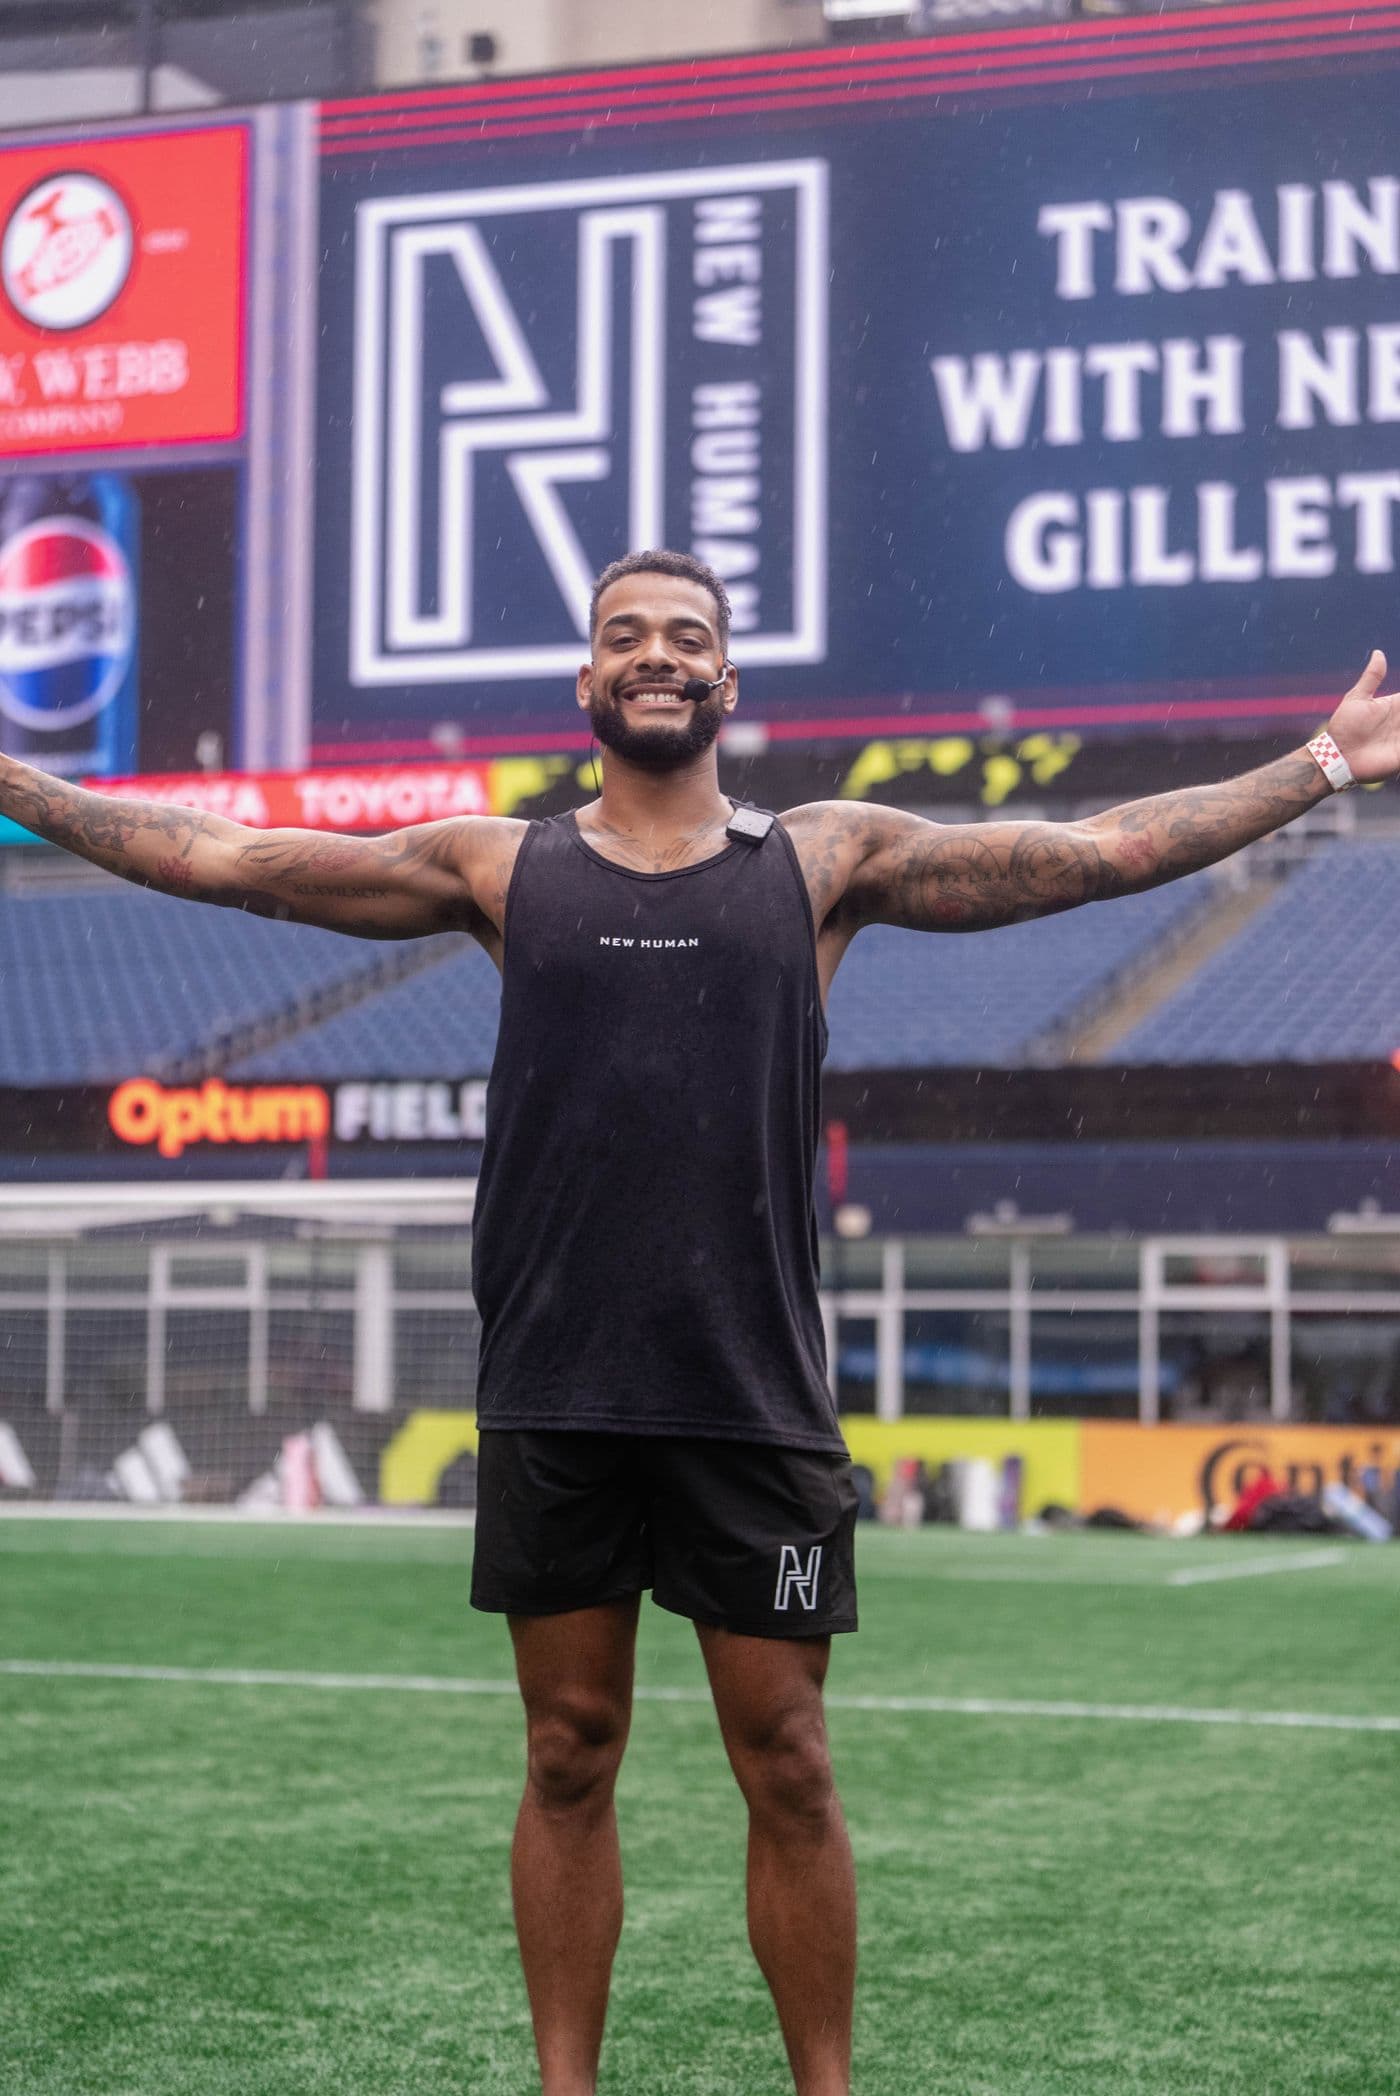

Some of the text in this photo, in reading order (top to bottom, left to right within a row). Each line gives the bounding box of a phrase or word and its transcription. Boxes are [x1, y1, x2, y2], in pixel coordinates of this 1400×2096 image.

[693, 196, 762, 346] NEW
[1037, 175, 1400, 299] TRAIN
[32, 338, 189, 401] WEBB
[931, 323, 1400, 452] WITH NE
[1004, 469, 1400, 592] GILLET
[296, 769, 487, 825] TOYOTA
[599, 936, 699, 948] NEW HUMAN
[109, 1079, 329, 1158] Optum
